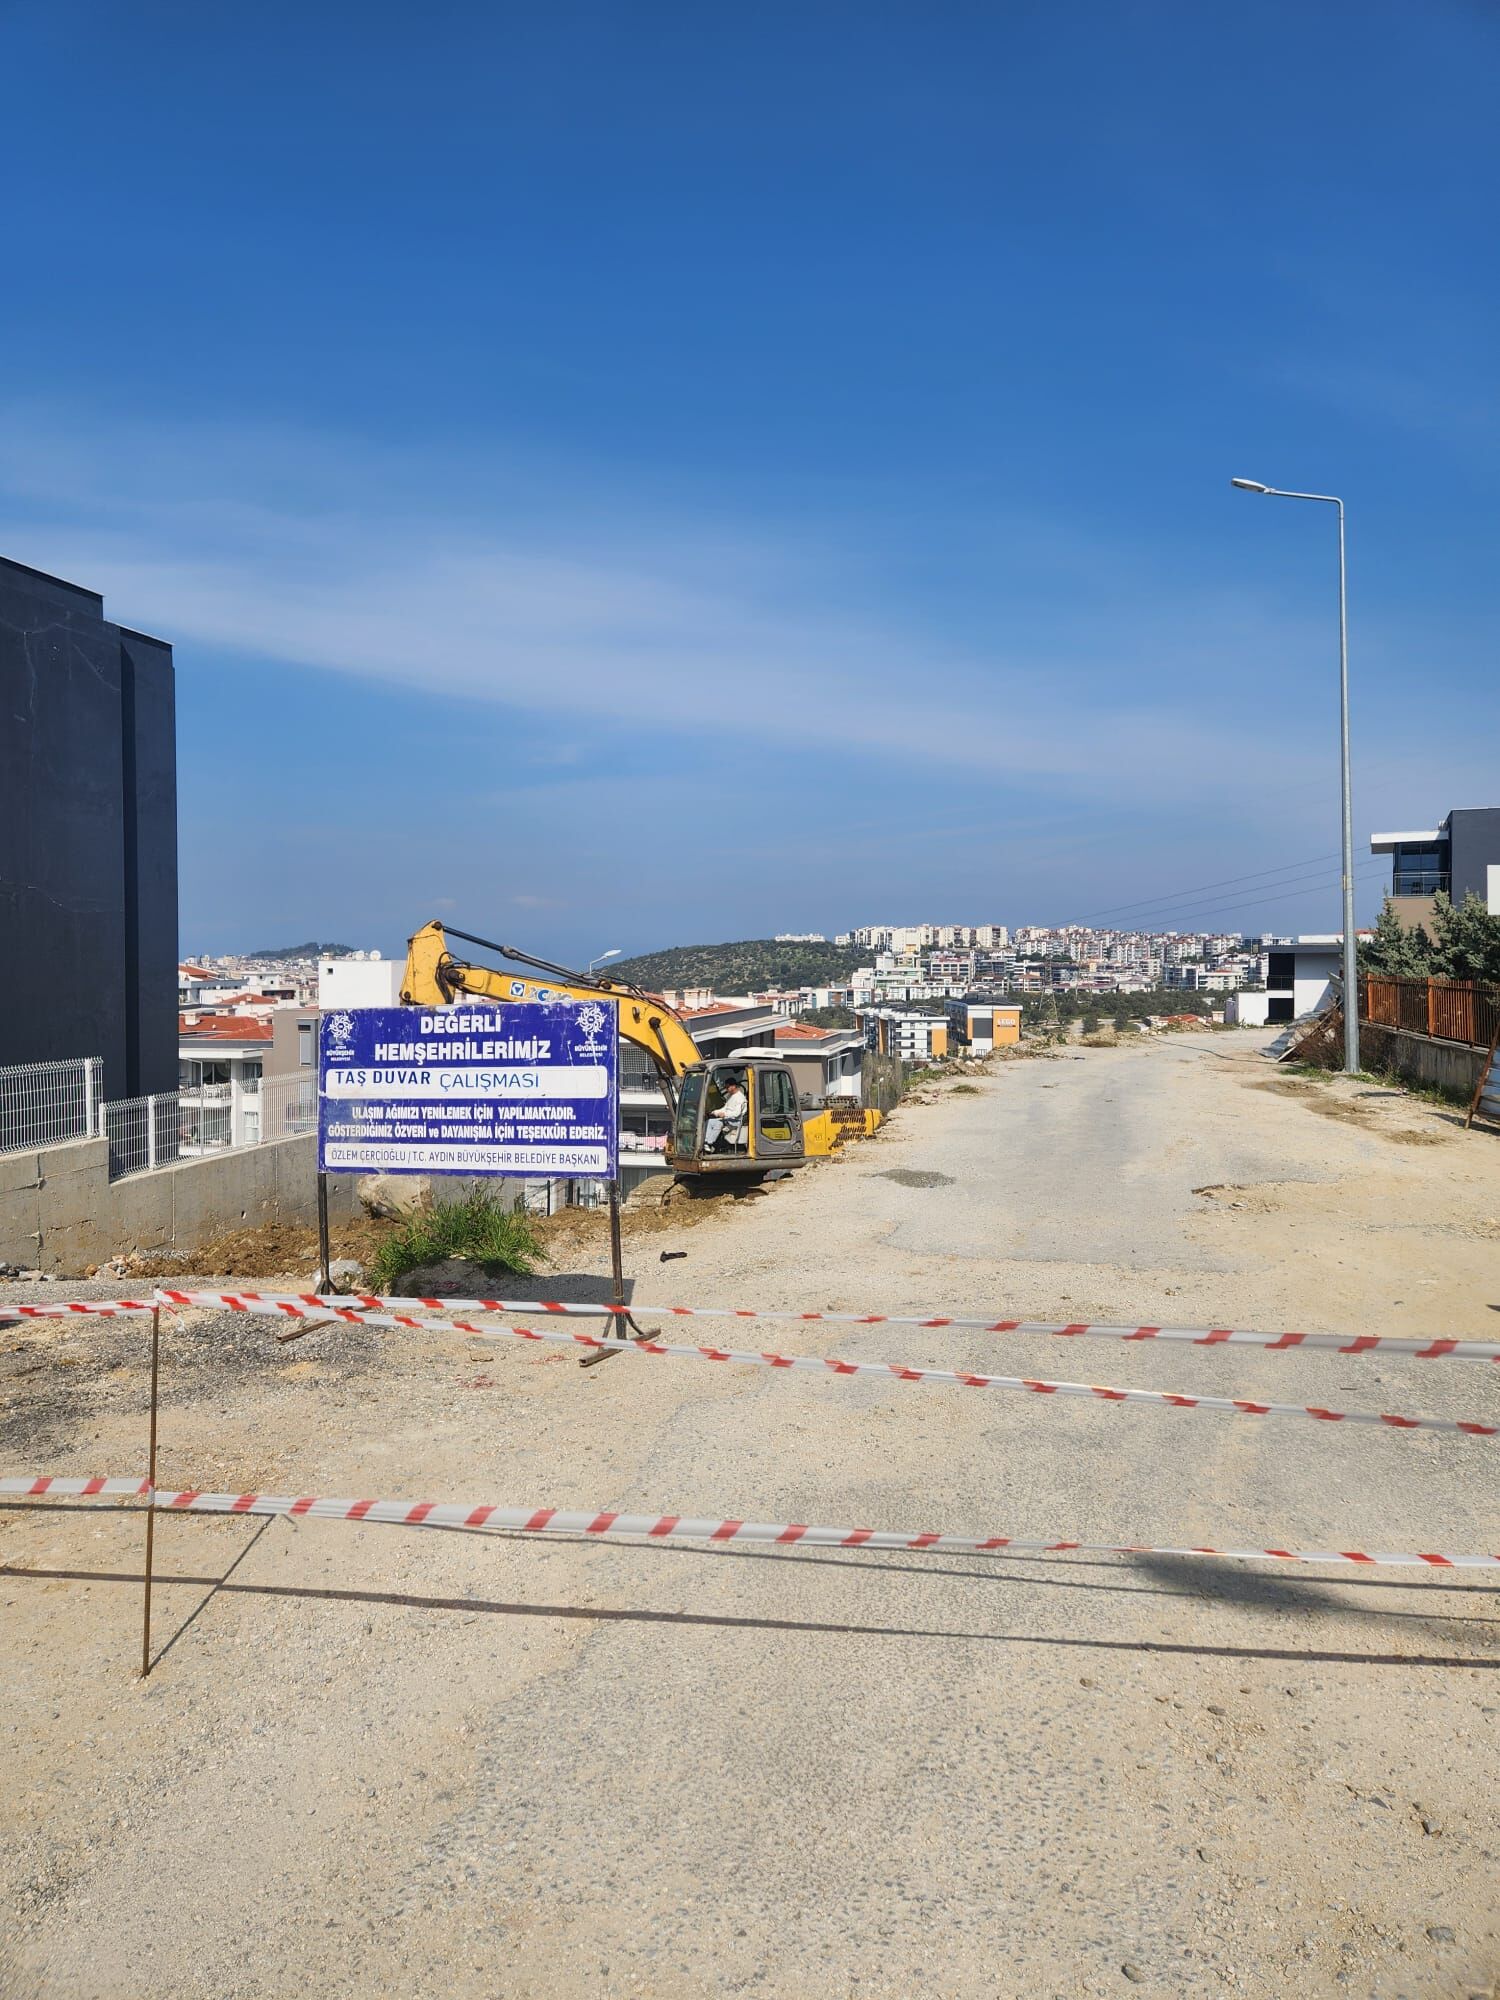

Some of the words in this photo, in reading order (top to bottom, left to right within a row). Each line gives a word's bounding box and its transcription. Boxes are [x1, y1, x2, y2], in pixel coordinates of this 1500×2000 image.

[420, 1009, 501, 1034] DEĞERLİ
[375, 1035, 551, 1065] HEMŞEHRİLERİMİZ
[335, 1070, 367, 1087] TAŞ
[373, 1070, 431, 1085] DUVAR
[439, 1073, 539, 1092] ÇALIŞMASI
[352, 1106, 384, 1123] ULAŞIM
[385, 1104, 419, 1120] AĞIMIZI
[420, 1104, 472, 1120] YENİLEMEK
[473, 1103, 494, 1123] İÇİN
[497, 1106, 577, 1120] YAPILMAKTADIR.
[328, 1121, 393, 1138] GÖSTERDİĞİNİZ
[394, 1122, 427, 1138] ÖZVERİ
[428, 1128, 439, 1138] ve
[441, 1124, 493, 1142] DAYANIŞMA
[494, 1122, 514, 1142] İÇİN
[516, 1123, 567, 1143] TEŞEKKÜR
[569, 1123, 608, 1140] EDERİZ.
[331, 1147, 358, 1161] ÖZLEM
[413, 1151, 427, 1162] T.C.
[428, 1151, 455, 1162] AYDIN
[457, 1149, 512, 1166] BÜYÜKŞEHİR
[514, 1150, 557, 1164] BELEDİYE
[559, 1152, 600, 1167] BAŞKANI
